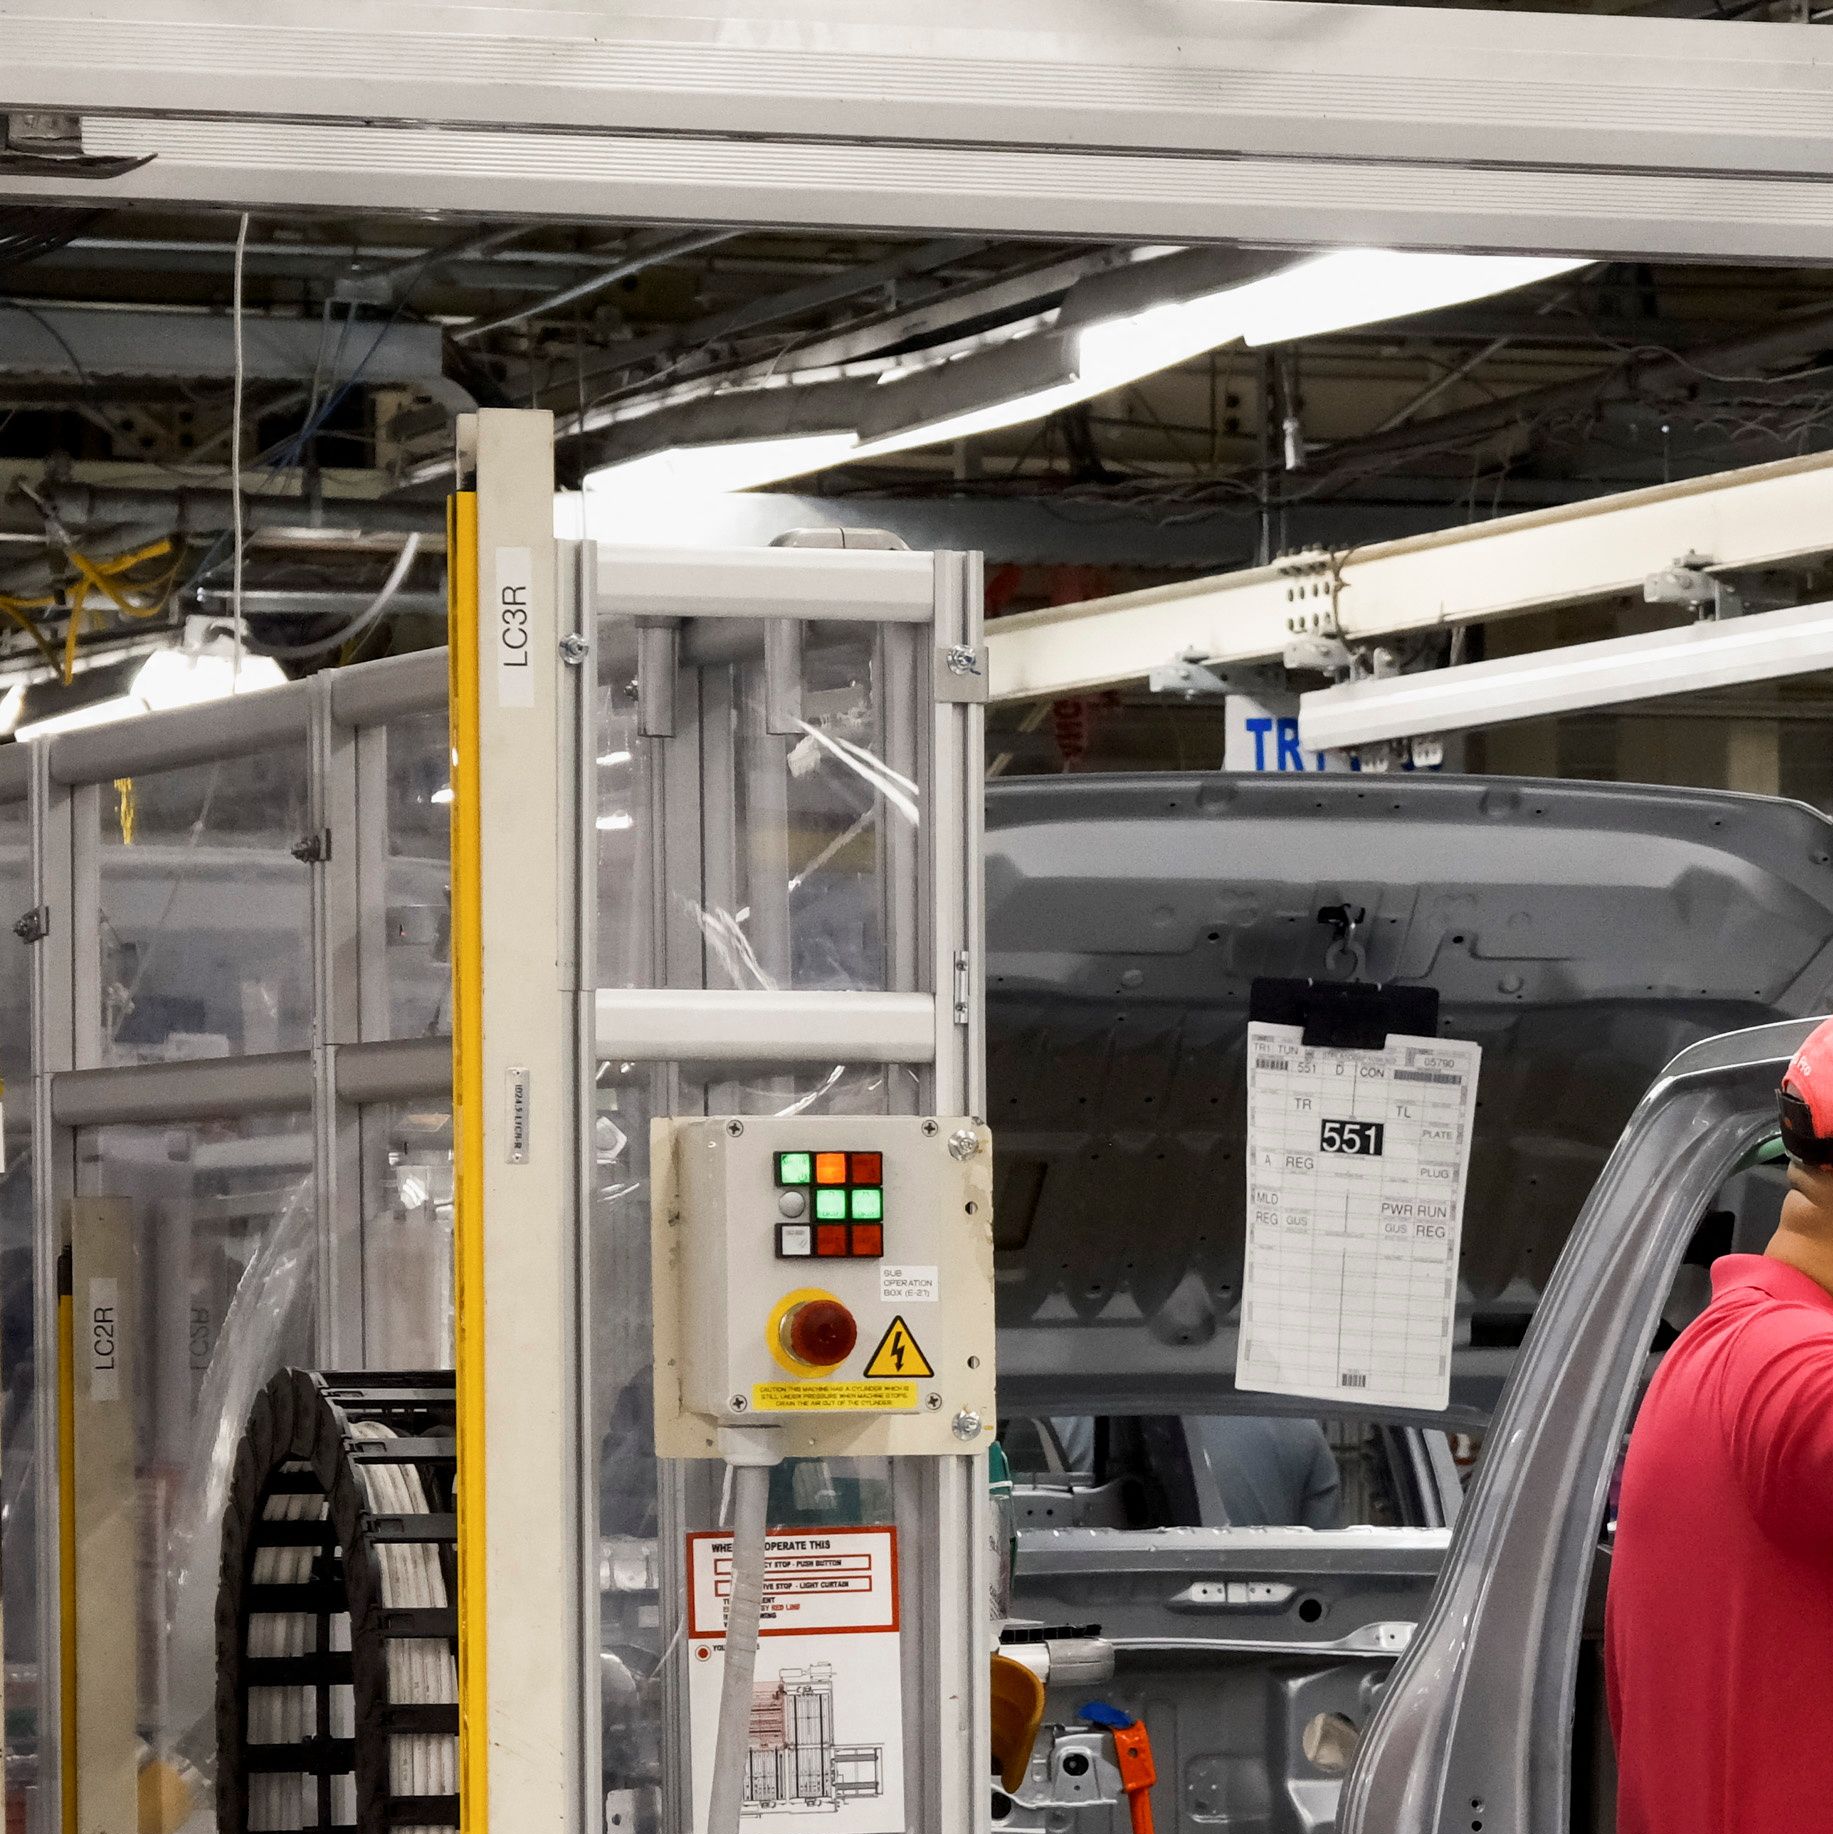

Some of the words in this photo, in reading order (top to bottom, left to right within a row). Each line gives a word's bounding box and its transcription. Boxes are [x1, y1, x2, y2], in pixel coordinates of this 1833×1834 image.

[502, 586, 528, 666] LC3R
[1297, 1061, 1316, 1074] 551
[1360, 1067, 1384, 1078] CON
[1295, 1098, 1311, 1110] TR
[1396, 1105, 1411, 1118] TL
[1322, 1122, 1376, 1154] 551
[1422, 1129, 1453, 1140] PLATE
[1285, 1156, 1314, 1169] REG
[1420, 1168, 1449, 1179] PLUG
[1257, 1192, 1279, 1205] MLD
[1381, 1202, 1413, 1216] PWR
[1417, 1204, 1447, 1218] RUN
[1256, 1211, 1278, 1226] REG
[1286, 1215, 1308, 1226] GUS
[1384, 1223, 1408, 1234] GUS
[1416, 1225, 1445, 1239] REG
[883, 1279, 932, 1287] OPERATION
[883, 1289, 901, 1297] BOX
[94, 1307, 114, 1370] LC2R
[765, 1541, 806, 1551] OPERATE
[810, 1540, 831, 1550] THIS
[796, 1560, 814, 1568] PUSH
